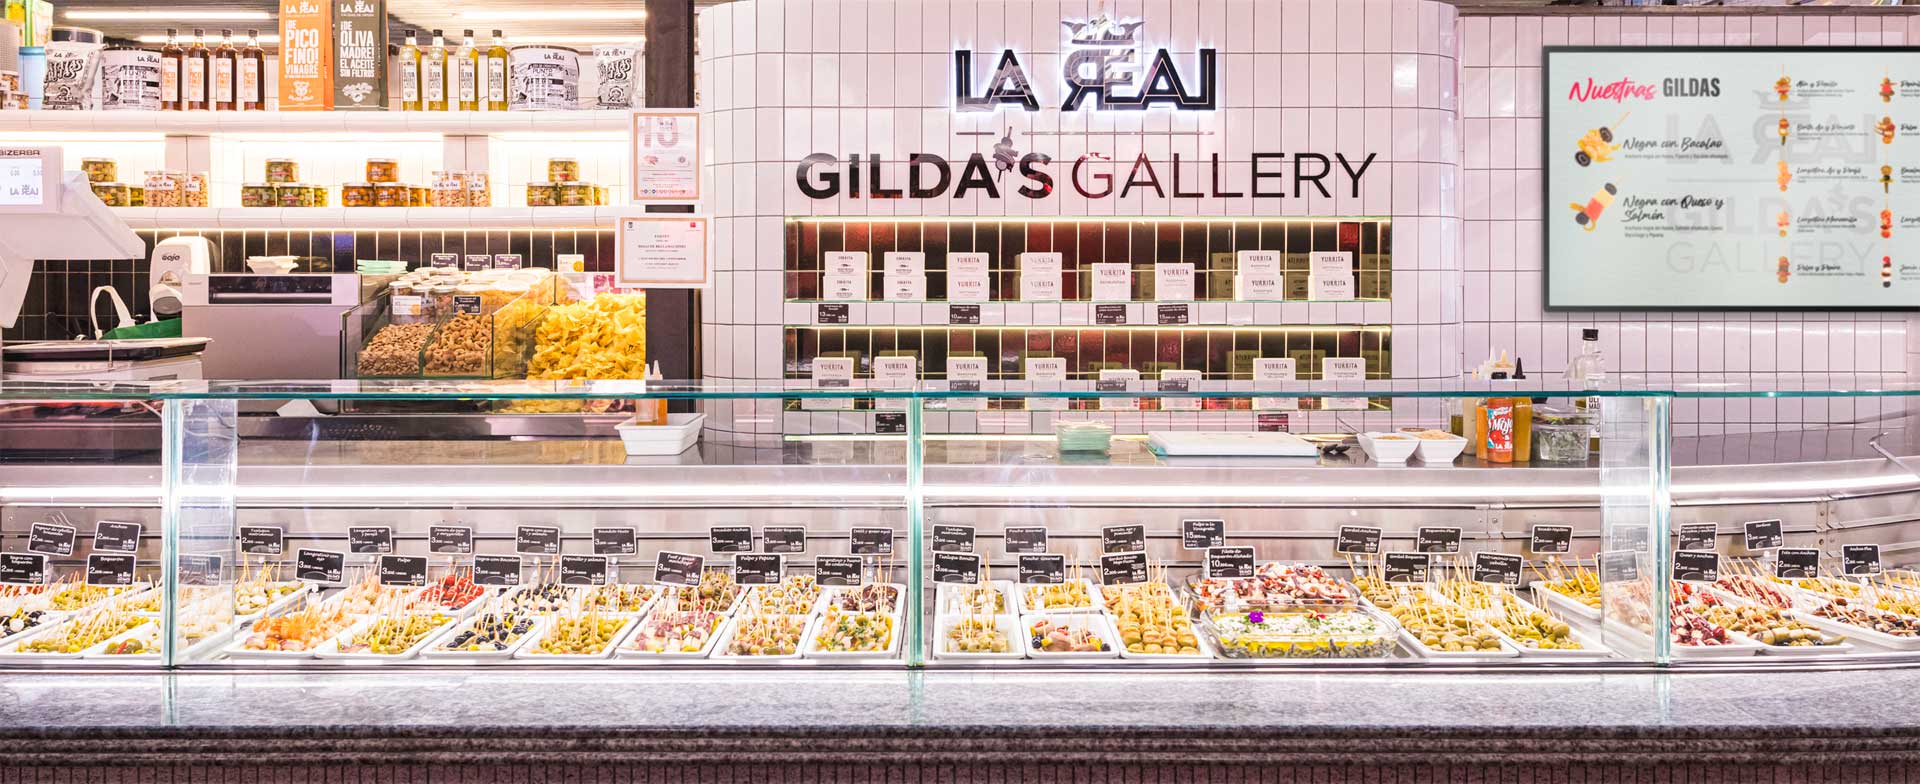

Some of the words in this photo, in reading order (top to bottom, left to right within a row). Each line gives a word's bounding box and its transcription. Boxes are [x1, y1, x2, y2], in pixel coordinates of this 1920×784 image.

[285, 4, 298, 14] LA
[341, 4, 352, 13] LA
[285, 30, 319, 47] PICO
[340, 31, 374, 46] OLIVA
[285, 48, 319, 65] FINO!
[340, 47, 374, 59] MADRE!
[285, 65, 319, 75] VINAGRE
[340, 59, 349, 69] EL
[351, 59, 374, 69] ACEITE
[955, 49, 1039, 111] LA
[1061, 47, 1216, 111] REAL
[1569, 77, 1656, 103] Nuestras
[1664, 78, 1721, 98] GILDAS
[1623, 137, 1657, 151] Negra
[1661, 140, 1678, 149] con
[1681, 137, 1722, 151] Bacalao
[796, 150, 1054, 200] GILDA'S
[1071, 151, 1376, 200] GALLERY
[1623, 195, 1657, 208] Negra
[1661, 198, 1679, 207] con
[1681, 194, 1712, 209] Queso
[1621, 208, 1665, 222] Salmón
[1249, 255, 1273, 263] YURRITA
[1251, 279, 1275, 287] YURRITA
[1264, 362, 1288, 370] YURRITA
[1333, 362, 1358, 370] YURRITA
